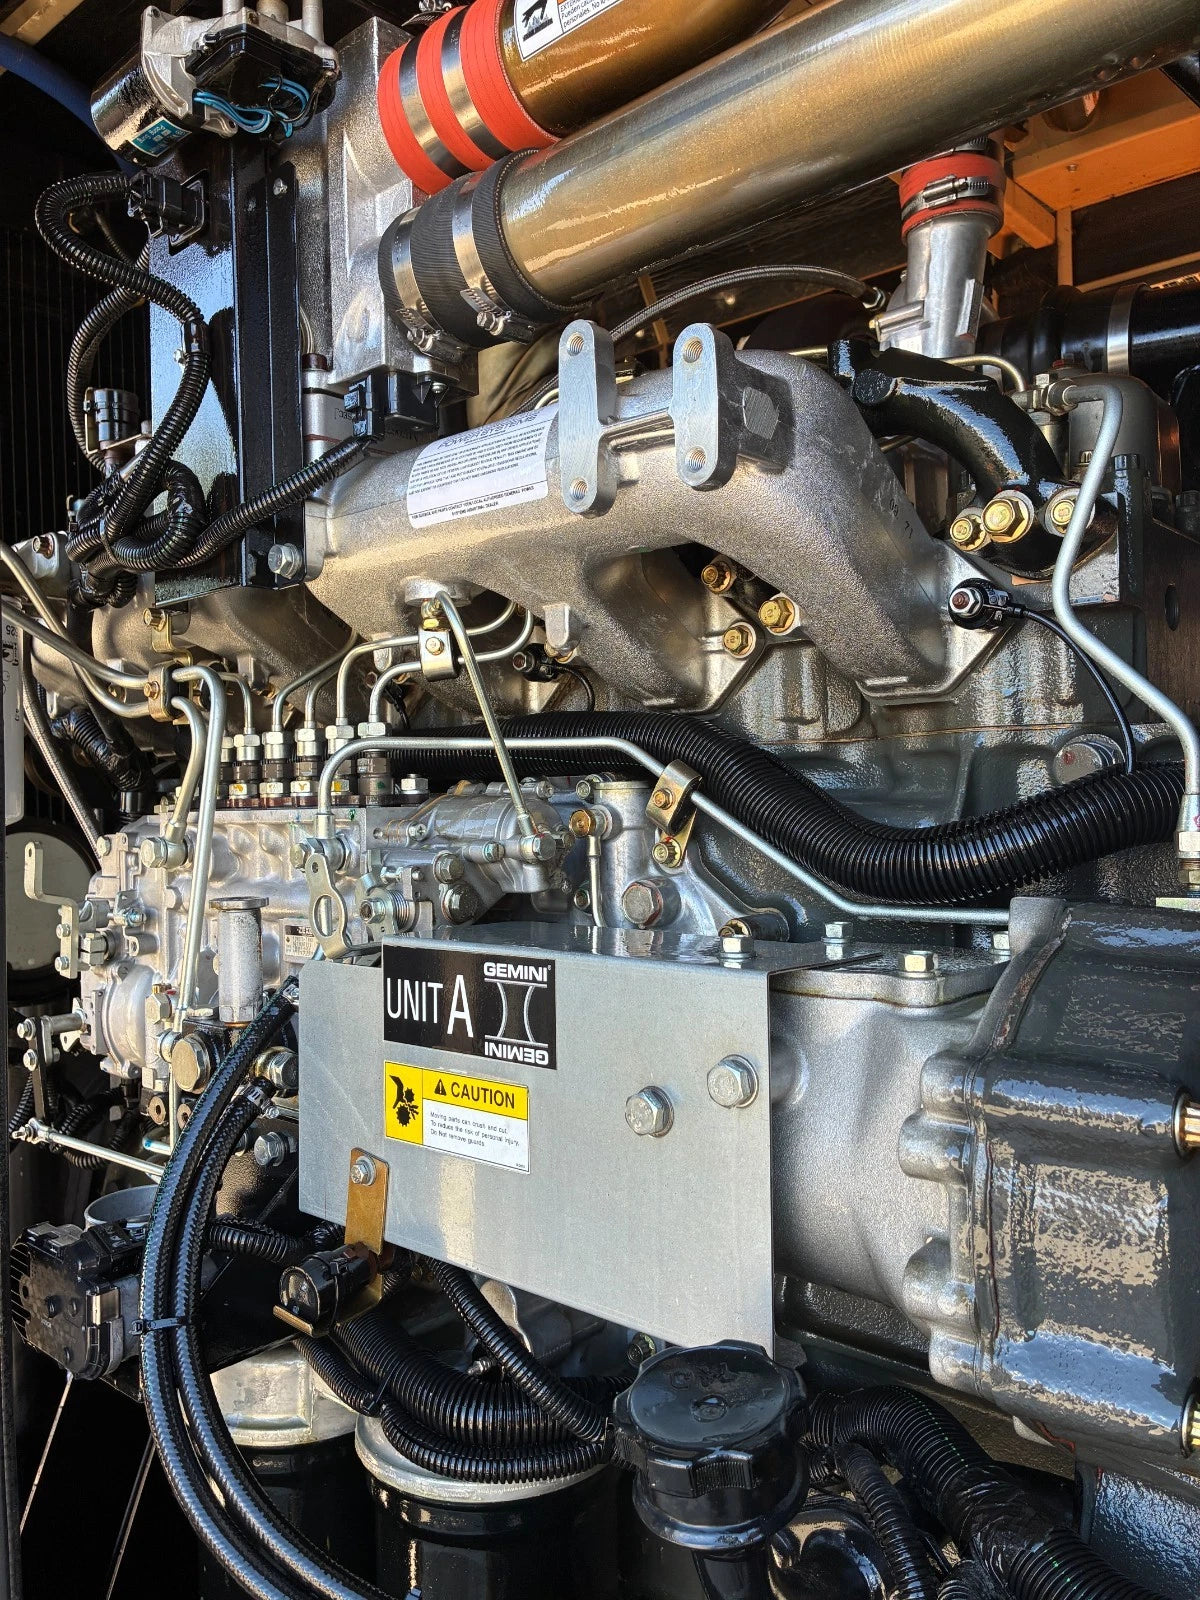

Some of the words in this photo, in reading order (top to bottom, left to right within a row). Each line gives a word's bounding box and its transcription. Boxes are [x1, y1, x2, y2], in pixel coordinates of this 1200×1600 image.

[483, 962, 548, 982] GEMINI
[386, 977, 443, 1024] UNIT
[446, 974, 474, 1038] A
[484, 1041, 549, 1065] GEMINI
[451, 1081, 515, 1110] CAUTION
[430, 1112, 446, 1121] Moving
